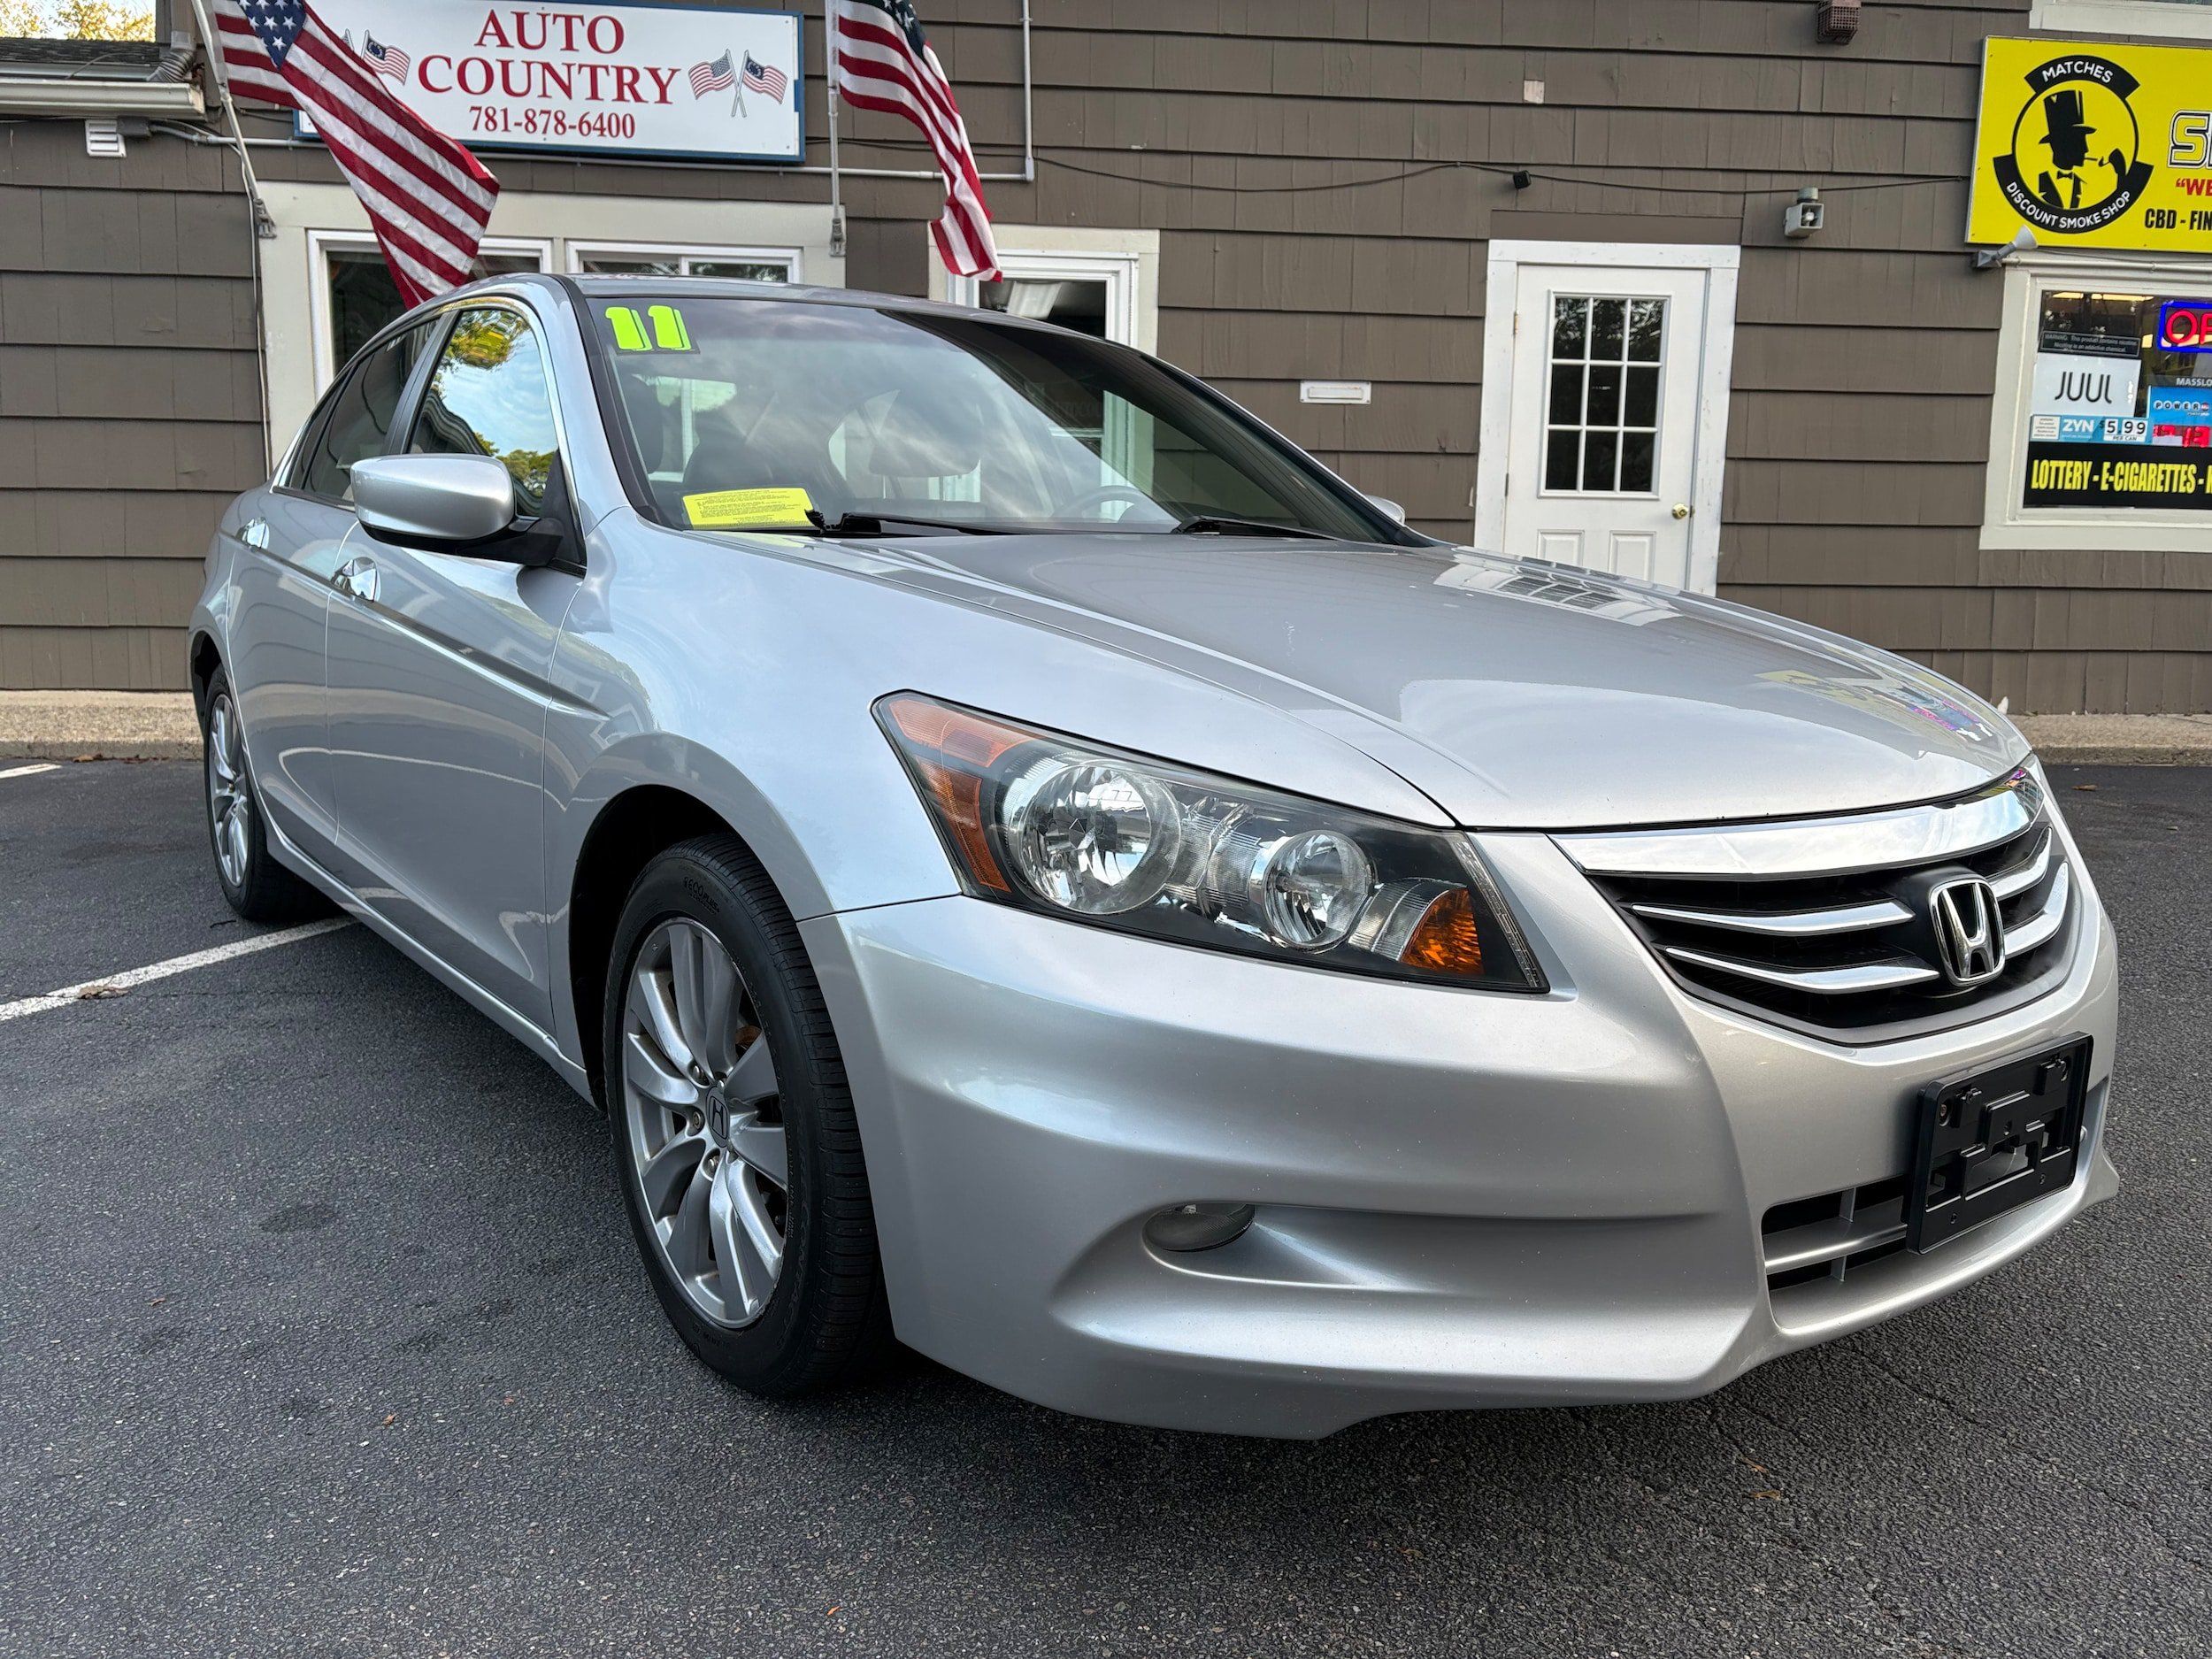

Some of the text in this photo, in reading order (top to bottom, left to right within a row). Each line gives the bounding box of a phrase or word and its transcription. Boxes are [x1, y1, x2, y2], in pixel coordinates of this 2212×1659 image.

[474, 8, 626, 54] AUTO
[418, 54, 681, 104] COUNTRY
[2041, 60, 2114, 83] MATCHES
[468, 105, 636, 139] 781-878-6400
[2006, 181, 2131, 229] DISCOUNT SMOKE SHOP
[2144, 207, 2177, 230] CBD
[604, 305, 692, 351] 11
[2054, 371, 2112, 404] JUUL
[2062, 419, 2094, 432] ZYN
[2031, 458, 2093, 491] LOTTERY
[2101, 461, 2198, 494] E-CIGARETTES
